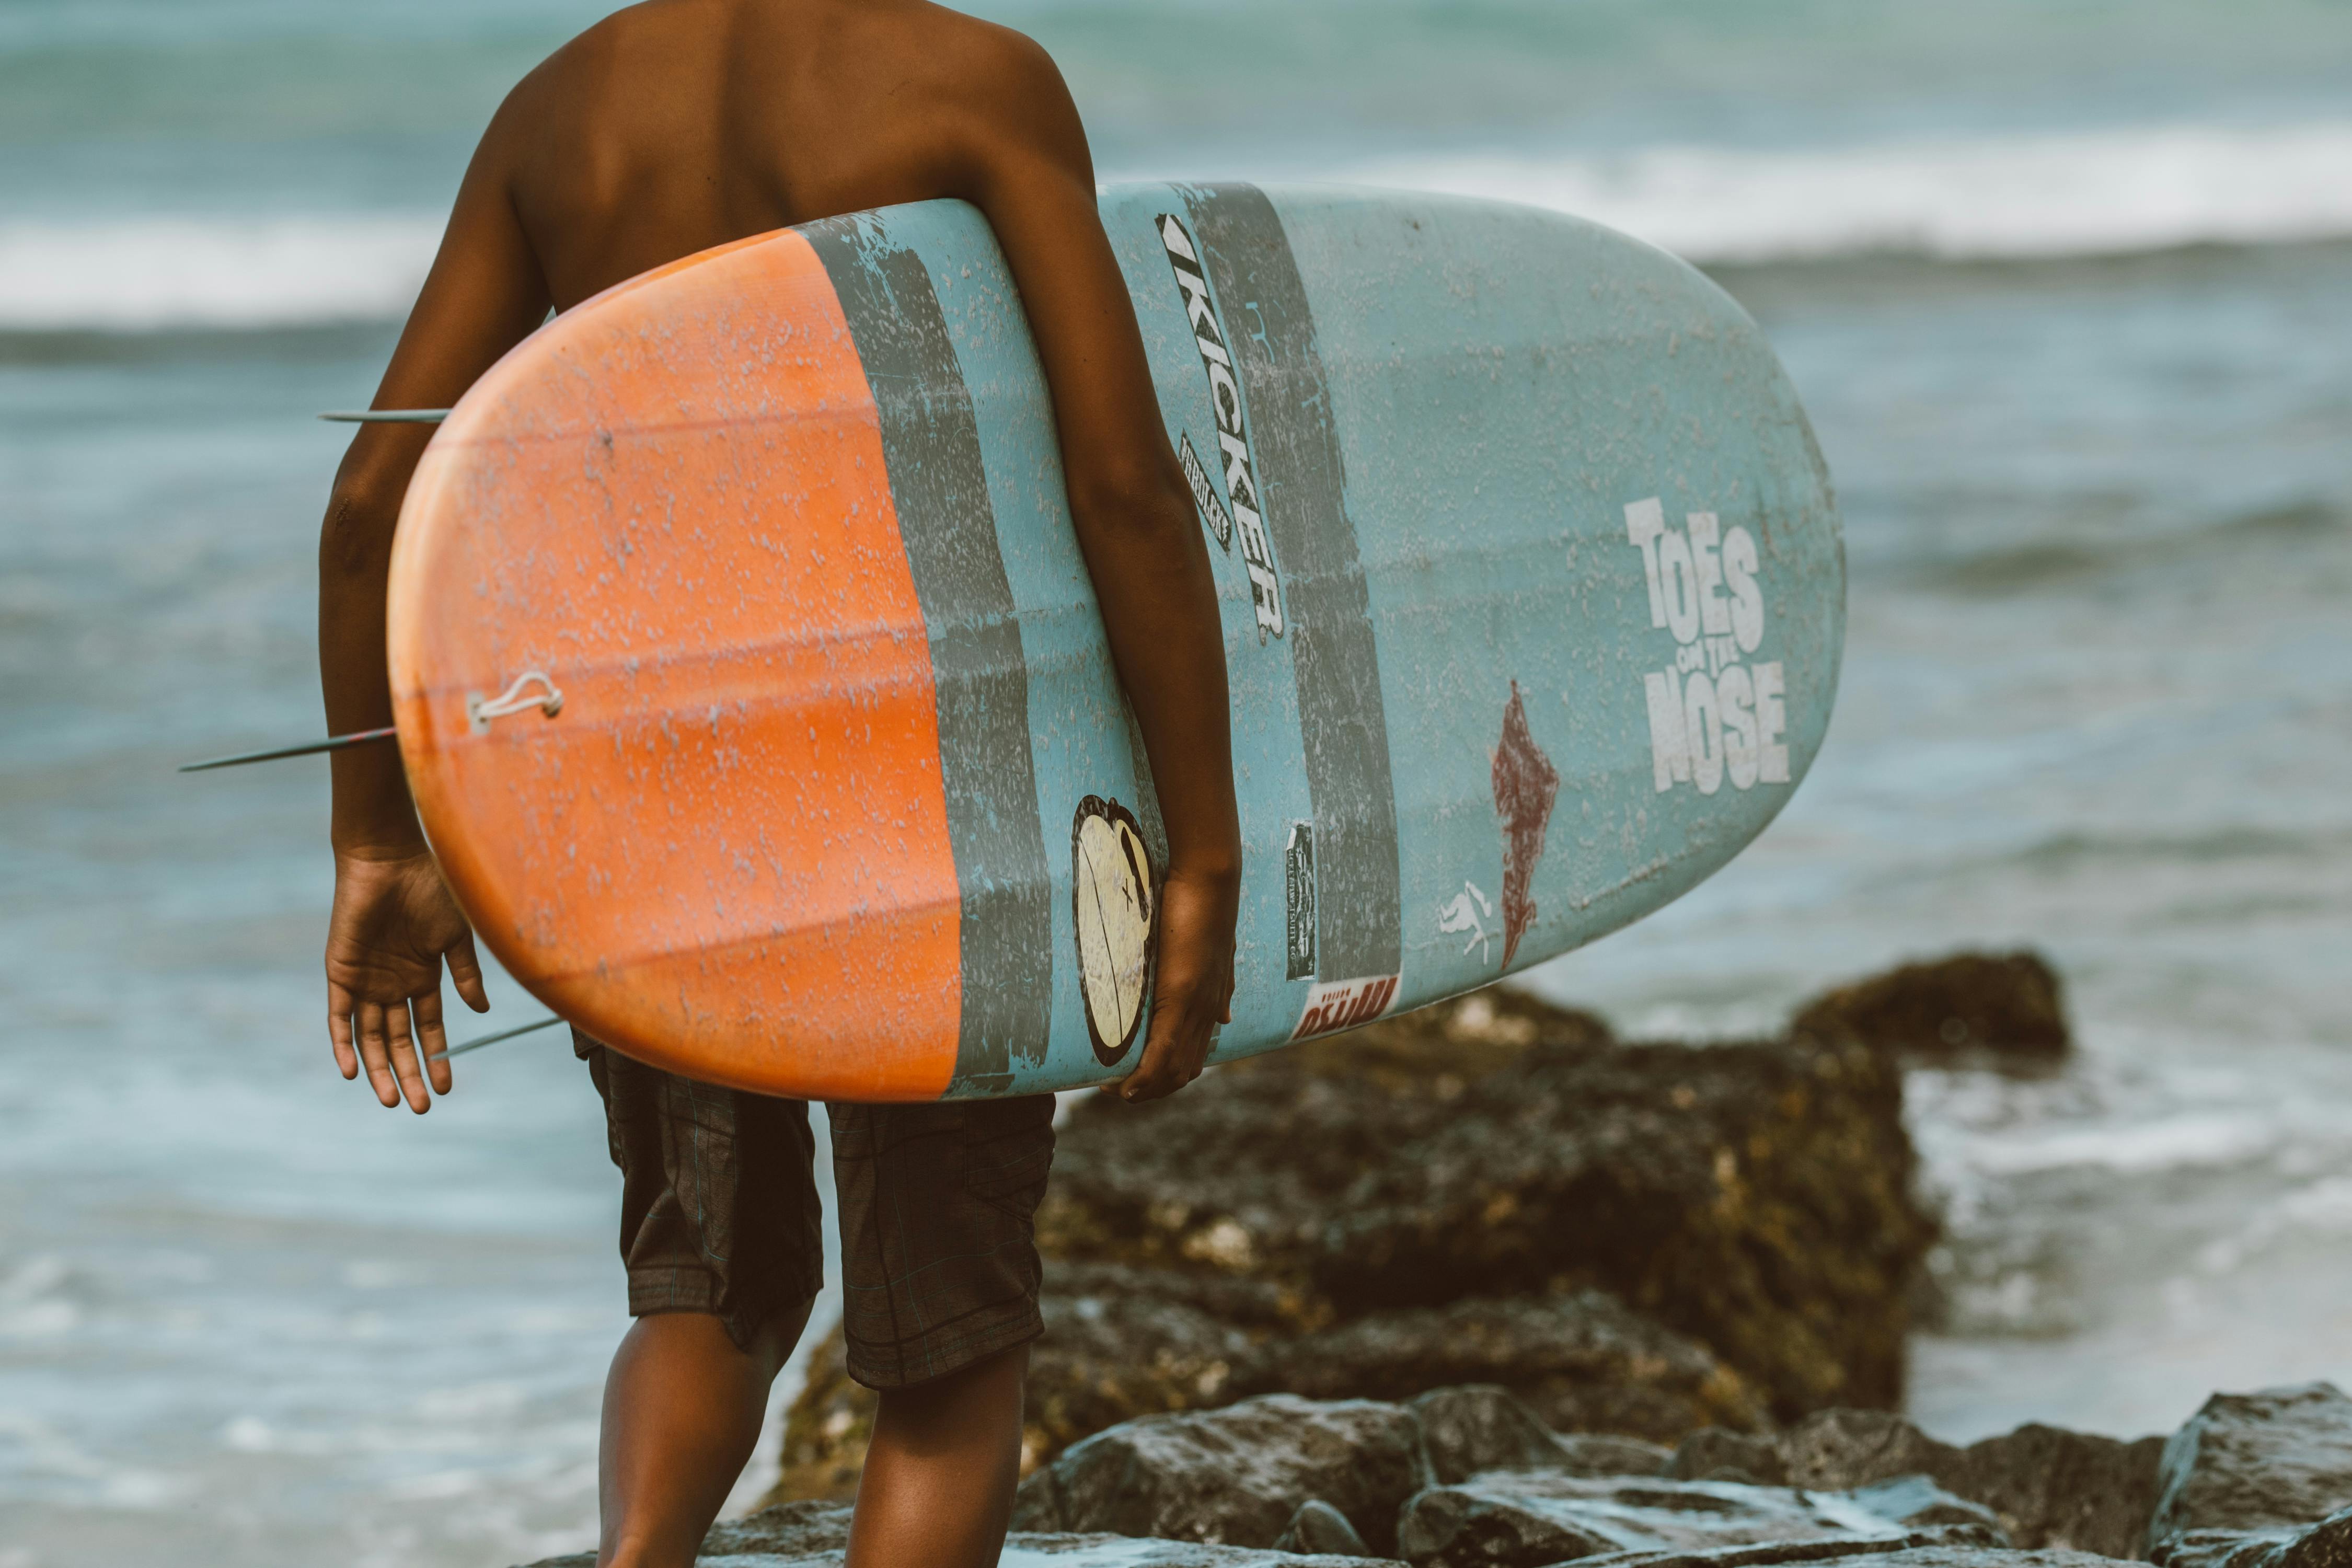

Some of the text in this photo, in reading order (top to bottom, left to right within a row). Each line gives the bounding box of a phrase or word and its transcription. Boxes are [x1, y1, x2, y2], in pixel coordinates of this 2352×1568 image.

[1174, 266, 1284, 639] KICKER
[1623, 496, 1765, 653] TOES
[1676, 636, 1739, 678] ON THE
[1644, 661, 1790, 795] NOSE
[1292, 976, 1398, 1041] MITSU
